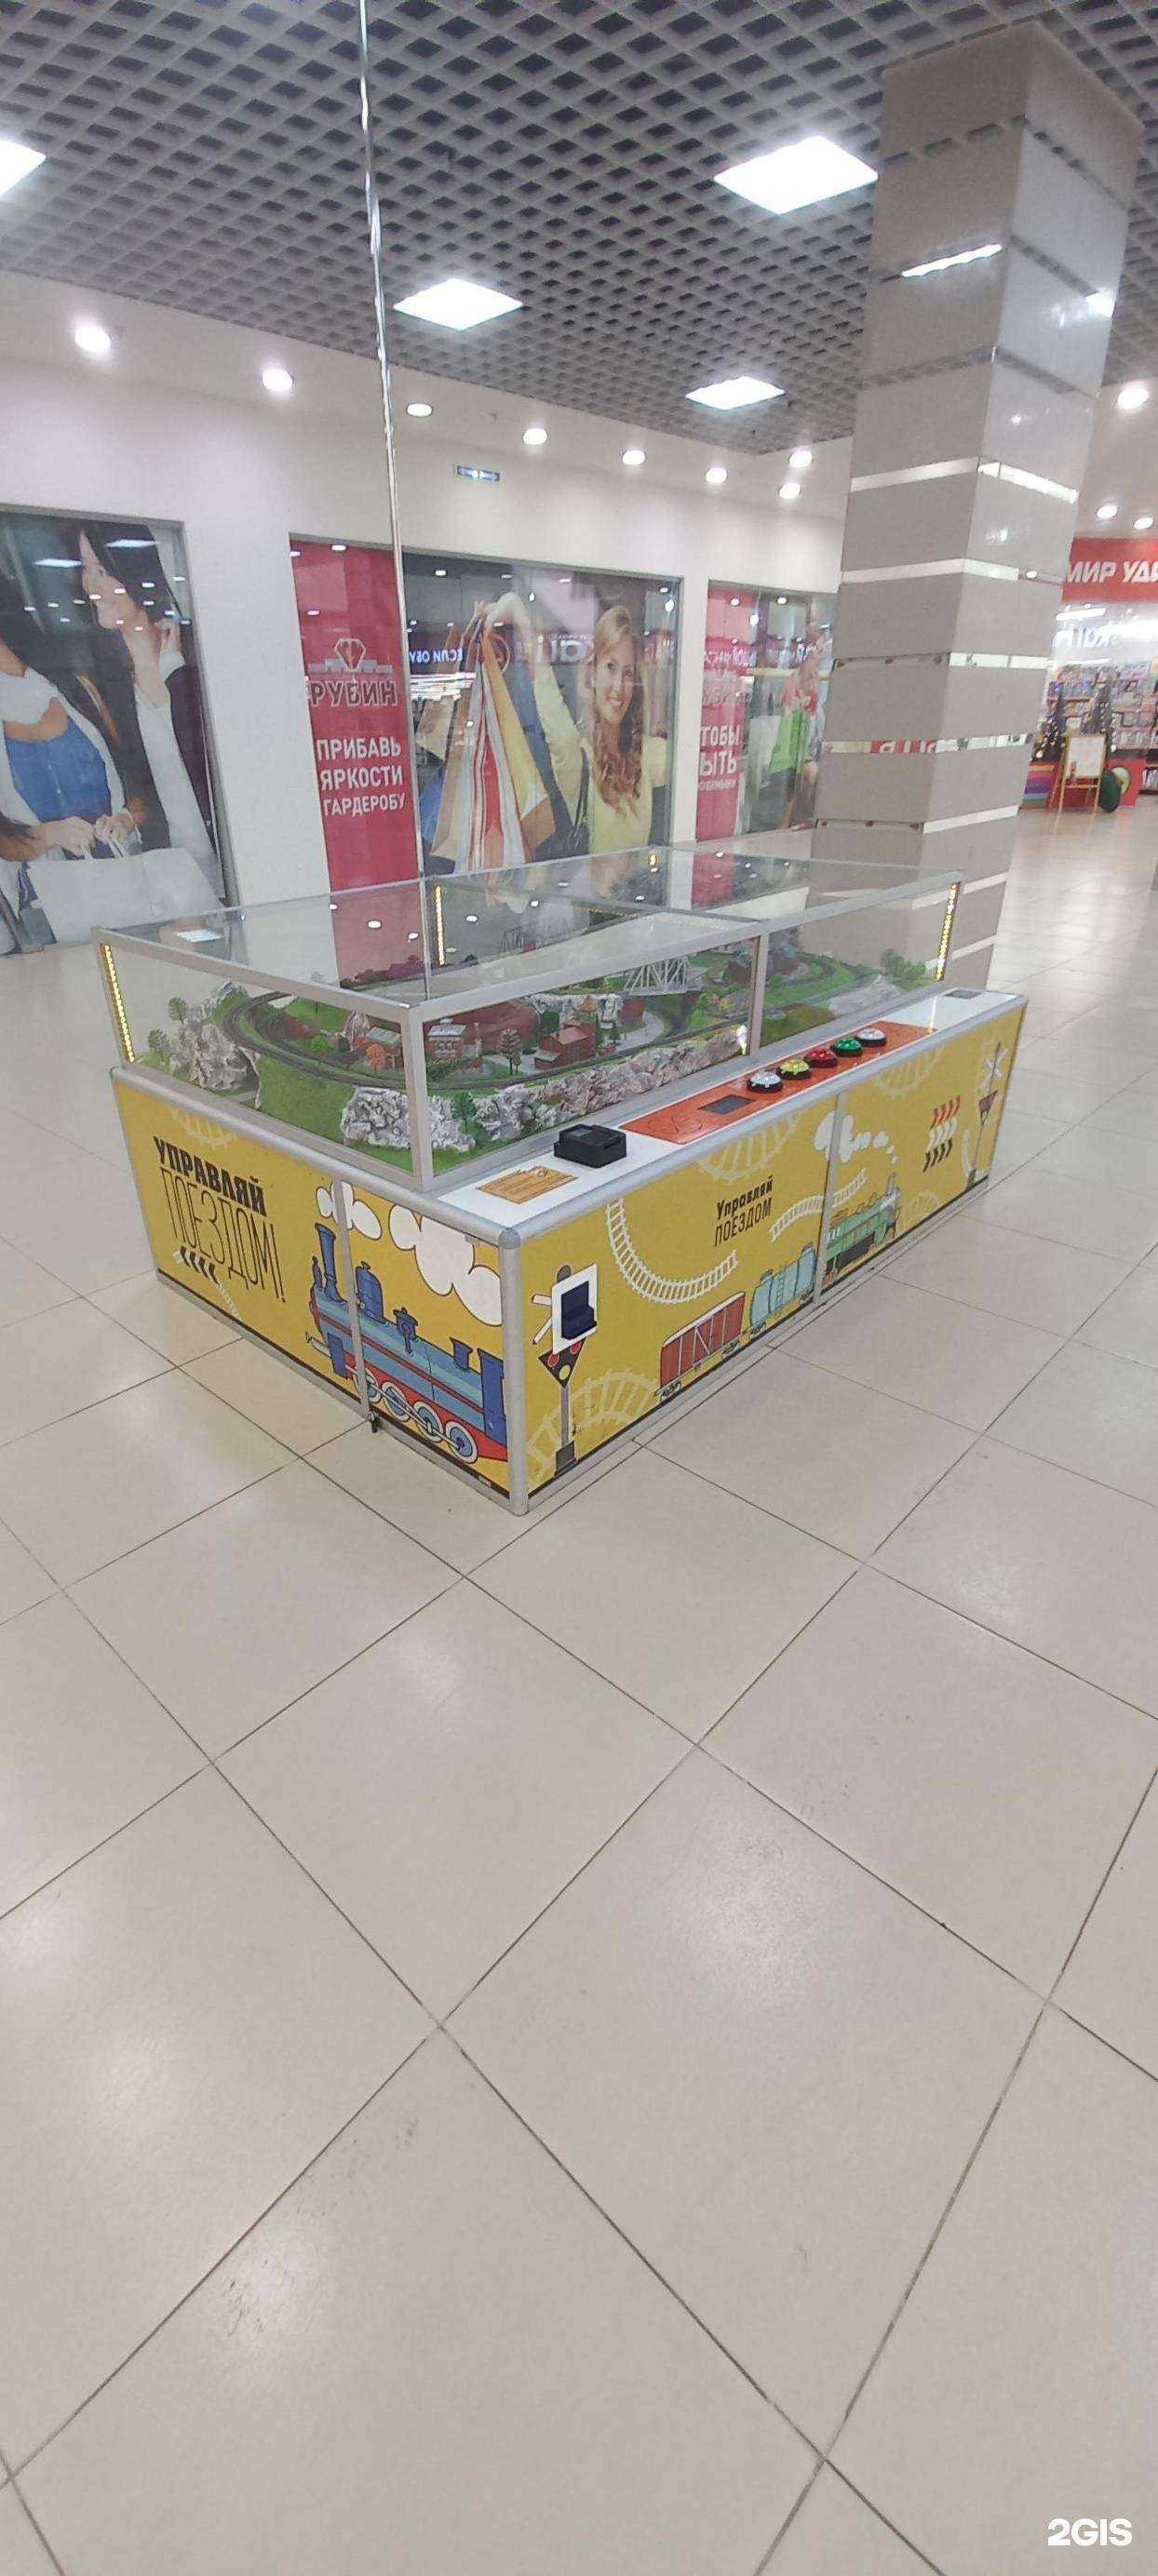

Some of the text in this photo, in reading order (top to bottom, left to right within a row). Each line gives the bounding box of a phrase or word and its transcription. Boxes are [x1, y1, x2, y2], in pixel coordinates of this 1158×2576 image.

[1066, 560, 1117, 584] МИР
[310, 680, 398, 707] РУБИН
[316, 736, 402, 761] ПРИБАВЬ
[700, 724, 741, 747] ТОБЫ
[699, 750, 738, 777] ЫТЬ
[320, 765, 404, 791] ЯРКОСТИ
[323, 793, 406, 817] ГАРДЕРОБУ
[153, 1135, 268, 1218] УПРАВЛЯЙ
[716, 1174, 774, 1221] Управляй
[160, 1166, 287, 1304] ПОЕЗДОМ!
[714, 1196, 773, 1247] ПОЕЗДОМ
